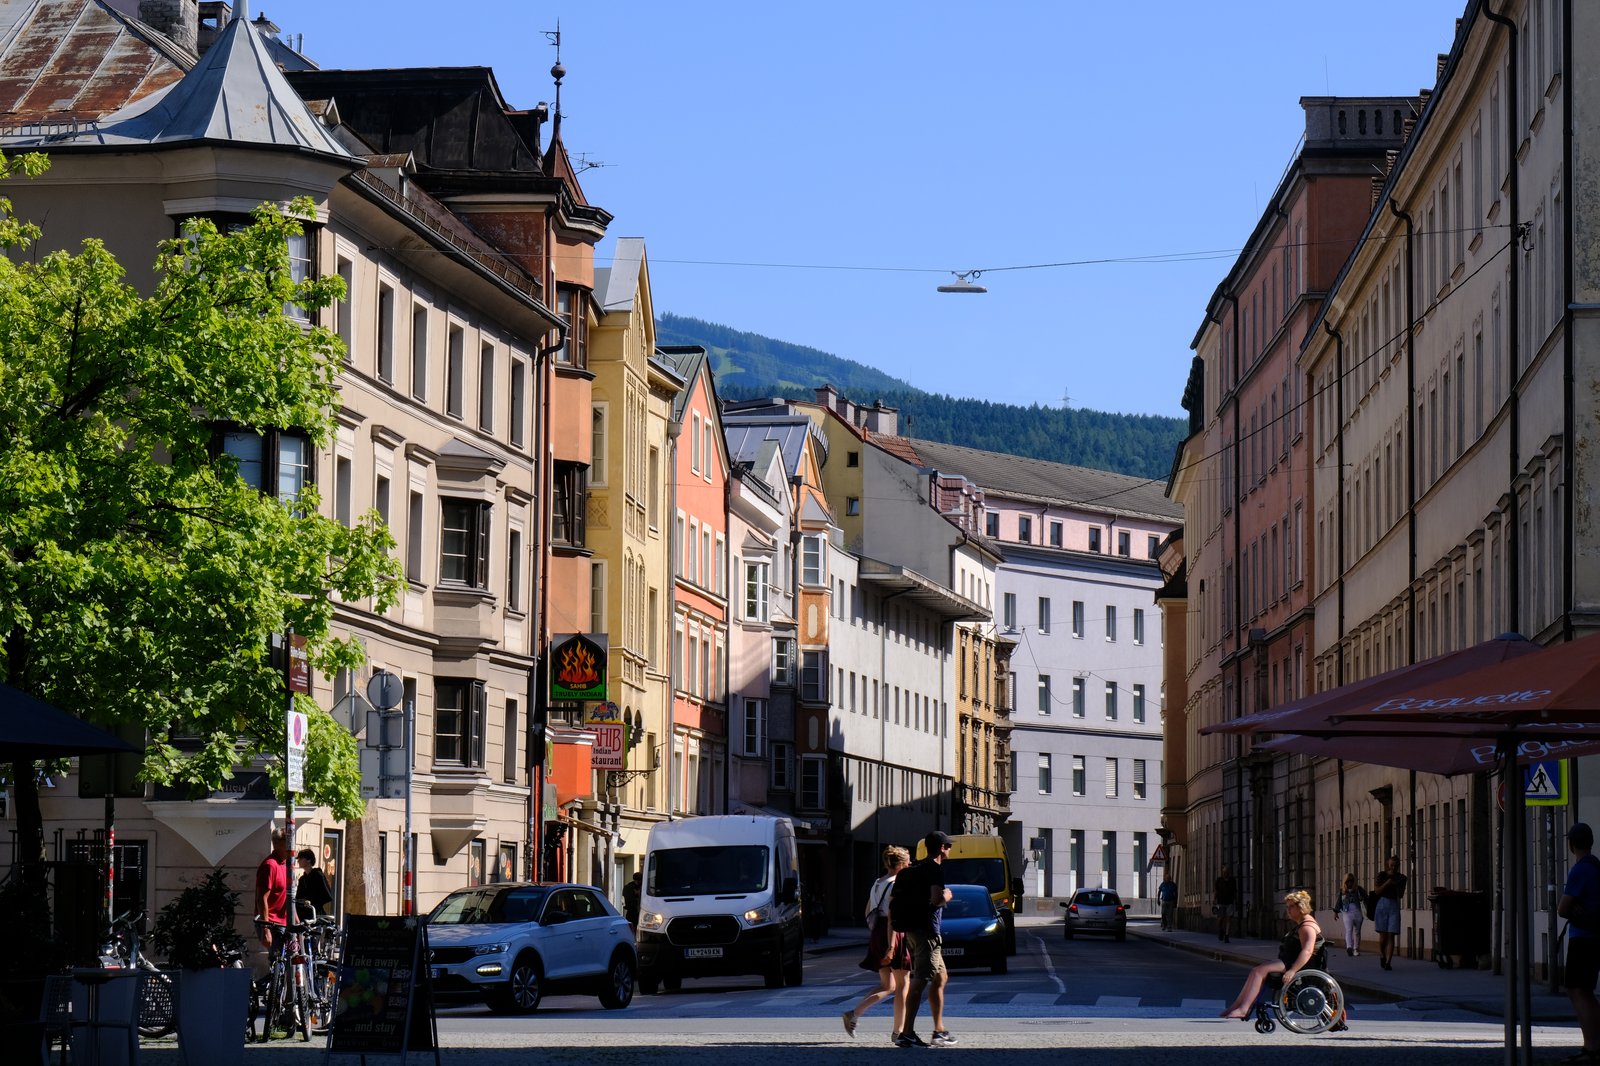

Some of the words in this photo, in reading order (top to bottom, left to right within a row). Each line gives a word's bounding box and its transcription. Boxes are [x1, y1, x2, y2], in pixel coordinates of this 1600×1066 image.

[1372, 689, 1552, 711] Baguette
[587, 727, 622, 752] AHIB
[593, 746, 612, 755] Indian
[592, 756, 622, 766] staurant
[350, 954, 371, 967] Take
[373, 959, 399, 968] away
[354, 1021, 373, 1033] and
[375, 1022, 396, 1036] stay
